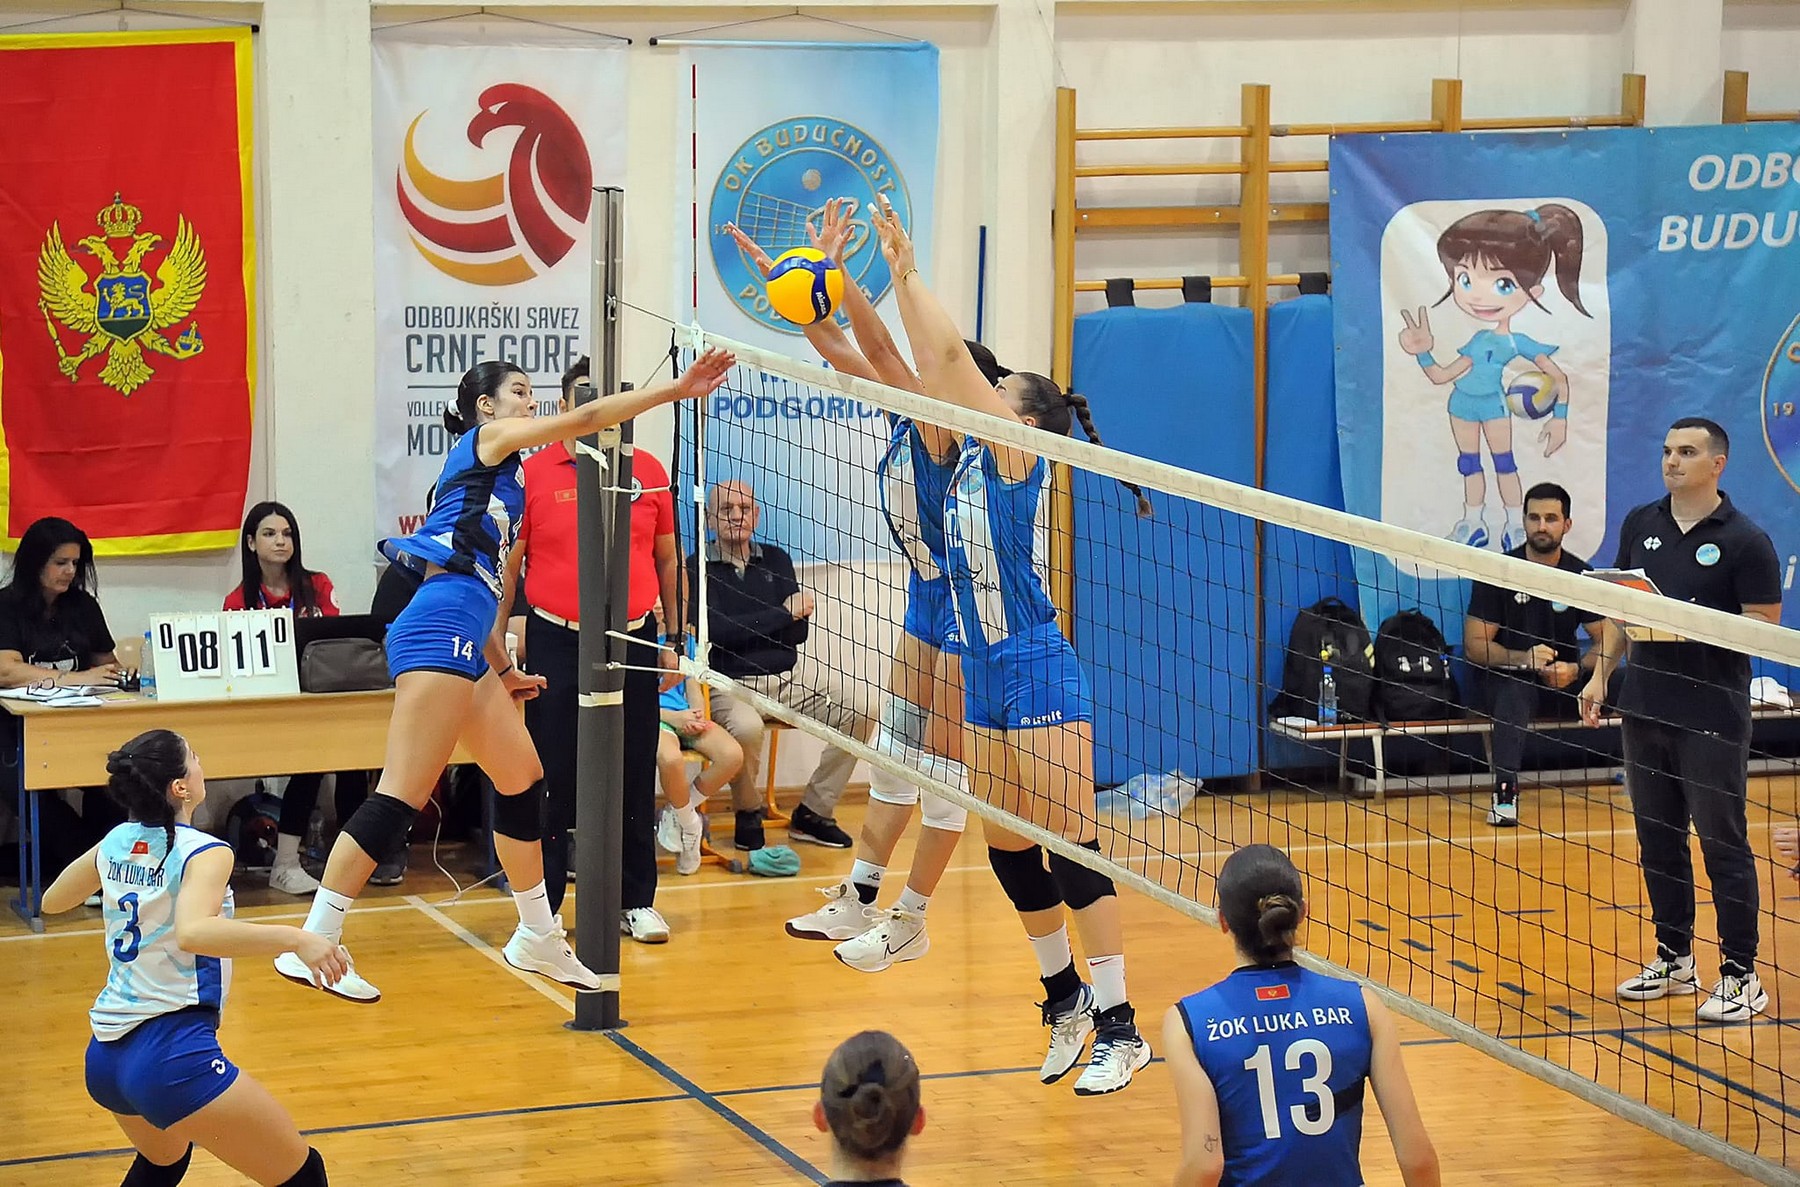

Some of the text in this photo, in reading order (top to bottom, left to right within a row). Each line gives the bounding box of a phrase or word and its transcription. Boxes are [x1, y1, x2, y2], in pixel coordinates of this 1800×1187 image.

[725, 124, 896, 192] OK BUDUĆNOST
[1688, 152, 1800, 191] ODB
[405, 302, 579, 329] ODBOJKAŠKI SAVEZ
[405, 334, 579, 373] CRNE GORE
[159, 617, 287, 672] 0 08 11 0
[452, 636, 474, 661] 14
[125, 864, 144, 886] LUKA
[147, 867, 165, 887] BAR
[113, 892, 141, 962] 3
[1207, 1007, 1354, 1041] ŽOK LUKA BAR
[1243, 1038, 1336, 1139] 13
